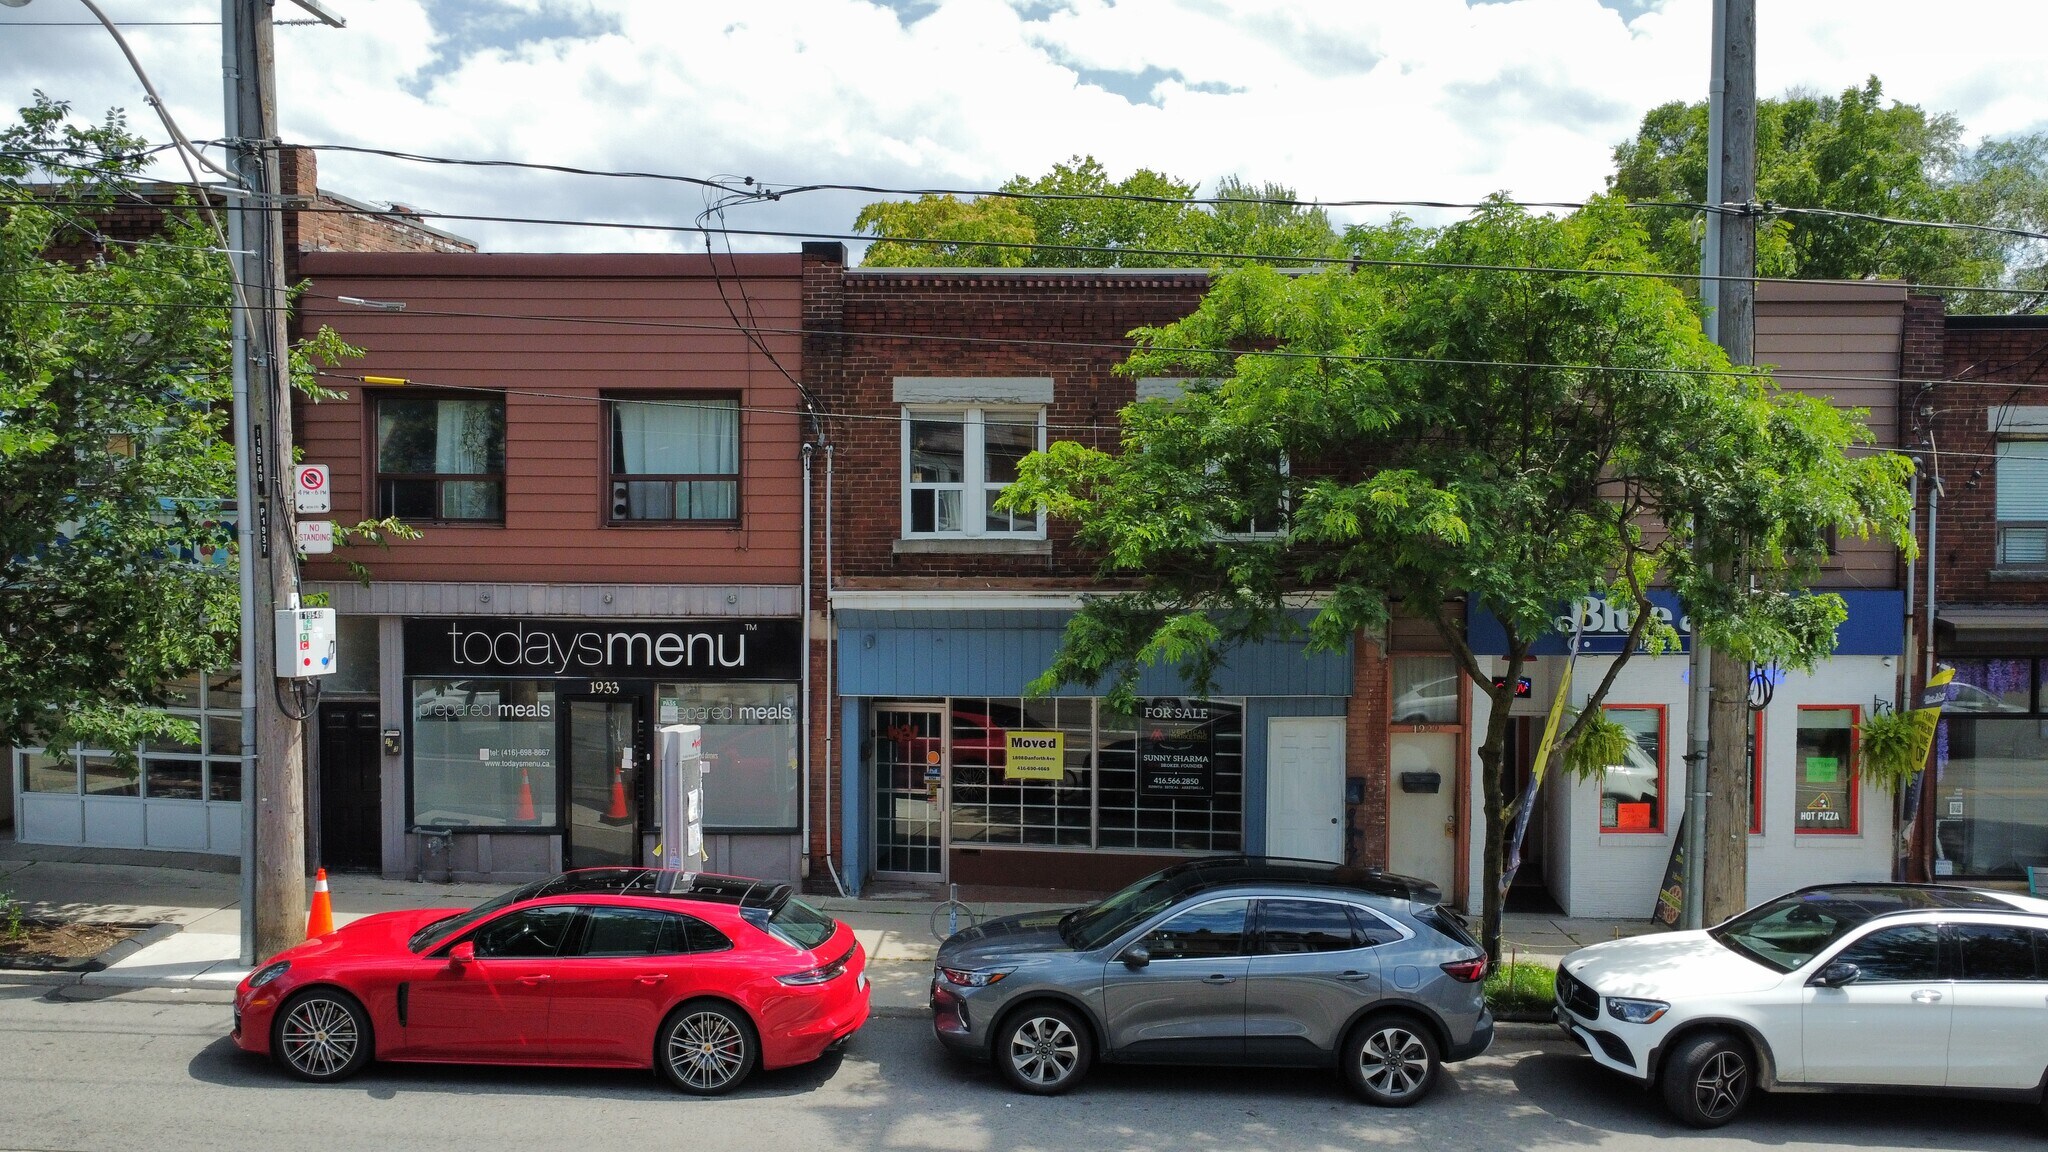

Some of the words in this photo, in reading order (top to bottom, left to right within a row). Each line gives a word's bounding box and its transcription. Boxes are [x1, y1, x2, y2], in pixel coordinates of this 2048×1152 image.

[309, 524, 320, 532] NO
[299, 533, 331, 541] STANDING
[589, 682, 620, 694] 1933
[419, 701, 492, 721] prepared
[497, 701, 550, 716] meals
[677, 704, 733, 723] epared
[739, 704, 791, 720] meals
[1144, 707, 1171, 719] FOR
[1174, 708, 1208, 719] SALE
[1011, 737, 1056, 749] Moved
[1143, 754, 1171, 762] SUNNY
[1172, 755, 1209, 763] SHARMA
[484, 760, 550, 769] www.todaysmenu.ca
[1153, 777, 1199, 785] 416.566.2850
[1800, 811, 1816, 821] HOT
[1817, 811, 1840, 821] PIZZA
